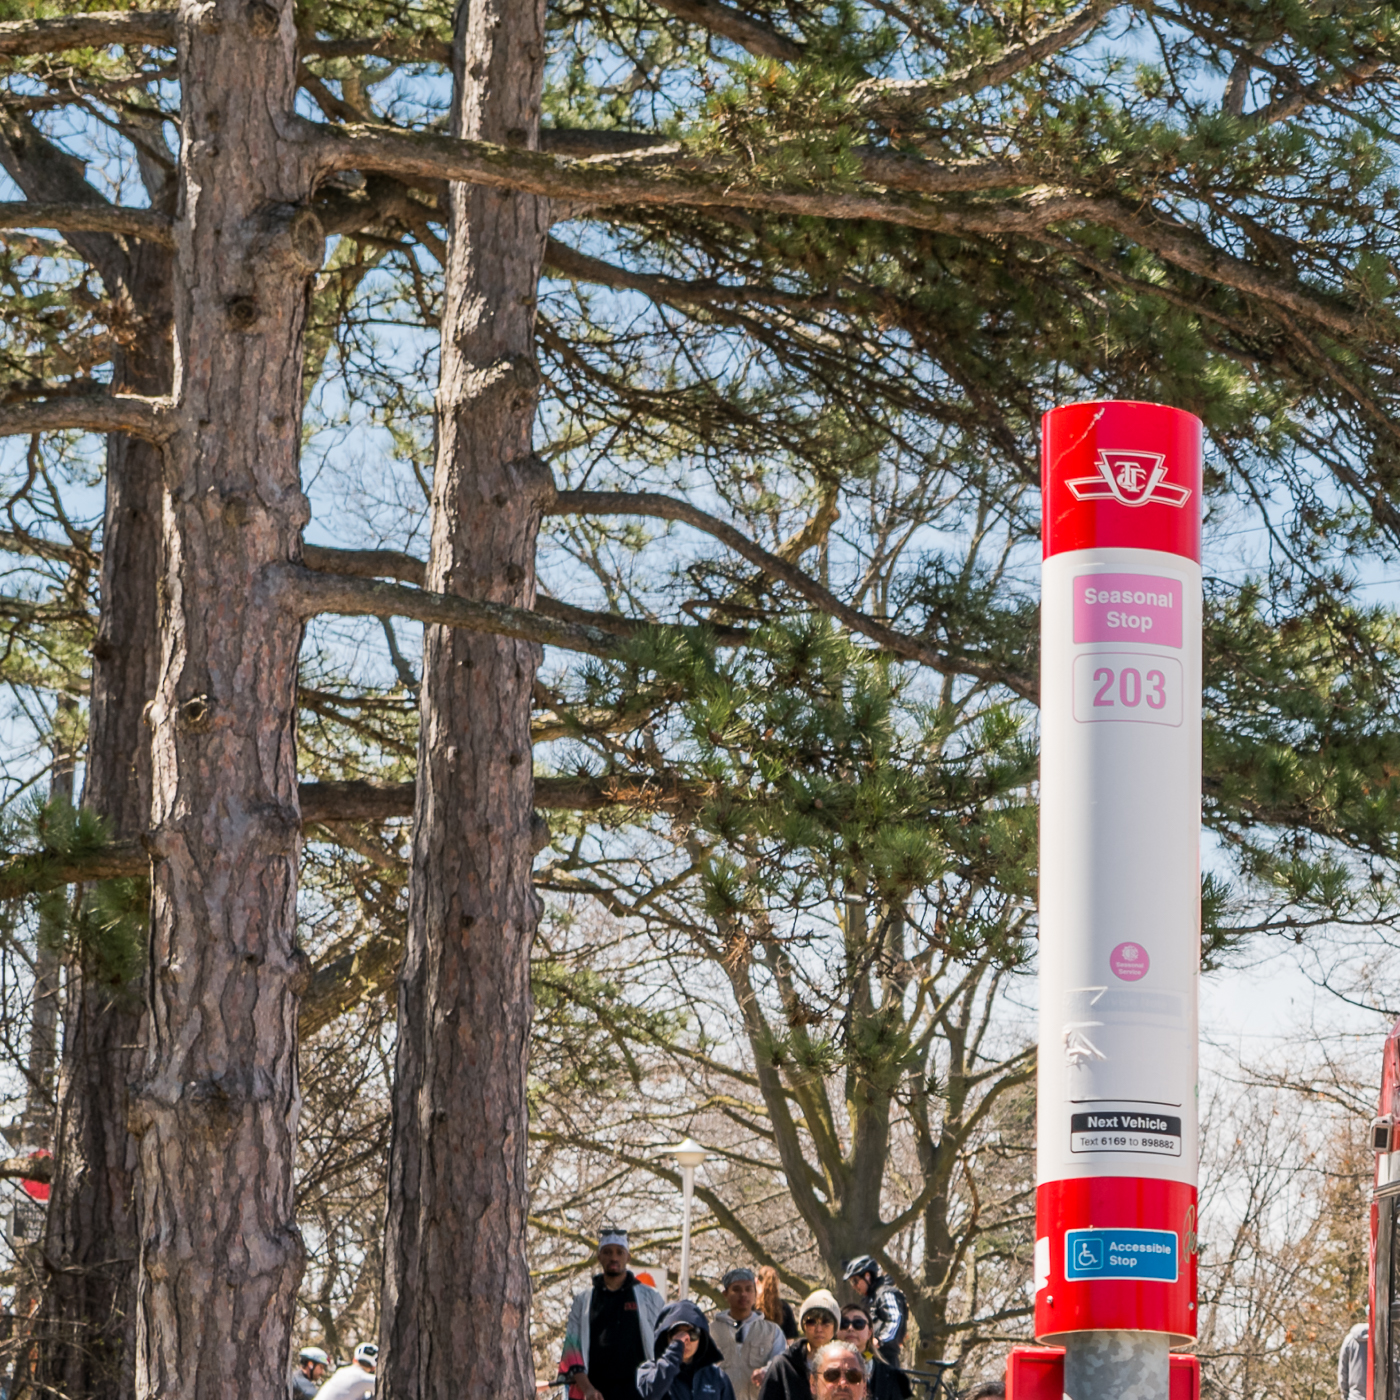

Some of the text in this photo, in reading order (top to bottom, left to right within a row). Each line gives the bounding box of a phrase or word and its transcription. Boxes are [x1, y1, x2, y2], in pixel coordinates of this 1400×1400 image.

[1084, 587, 1173, 608] Seasonal
[1106, 610, 1153, 633] Stop
[1092, 667, 1167, 711] 203
[1087, 1116, 1168, 1131] Next Vehicle
[1080, 1137, 1175, 1149] Text 6169 to 898882
[1109, 1241, 1172, 1255] Accessible
[1109, 1255, 1138, 1268] Stop
